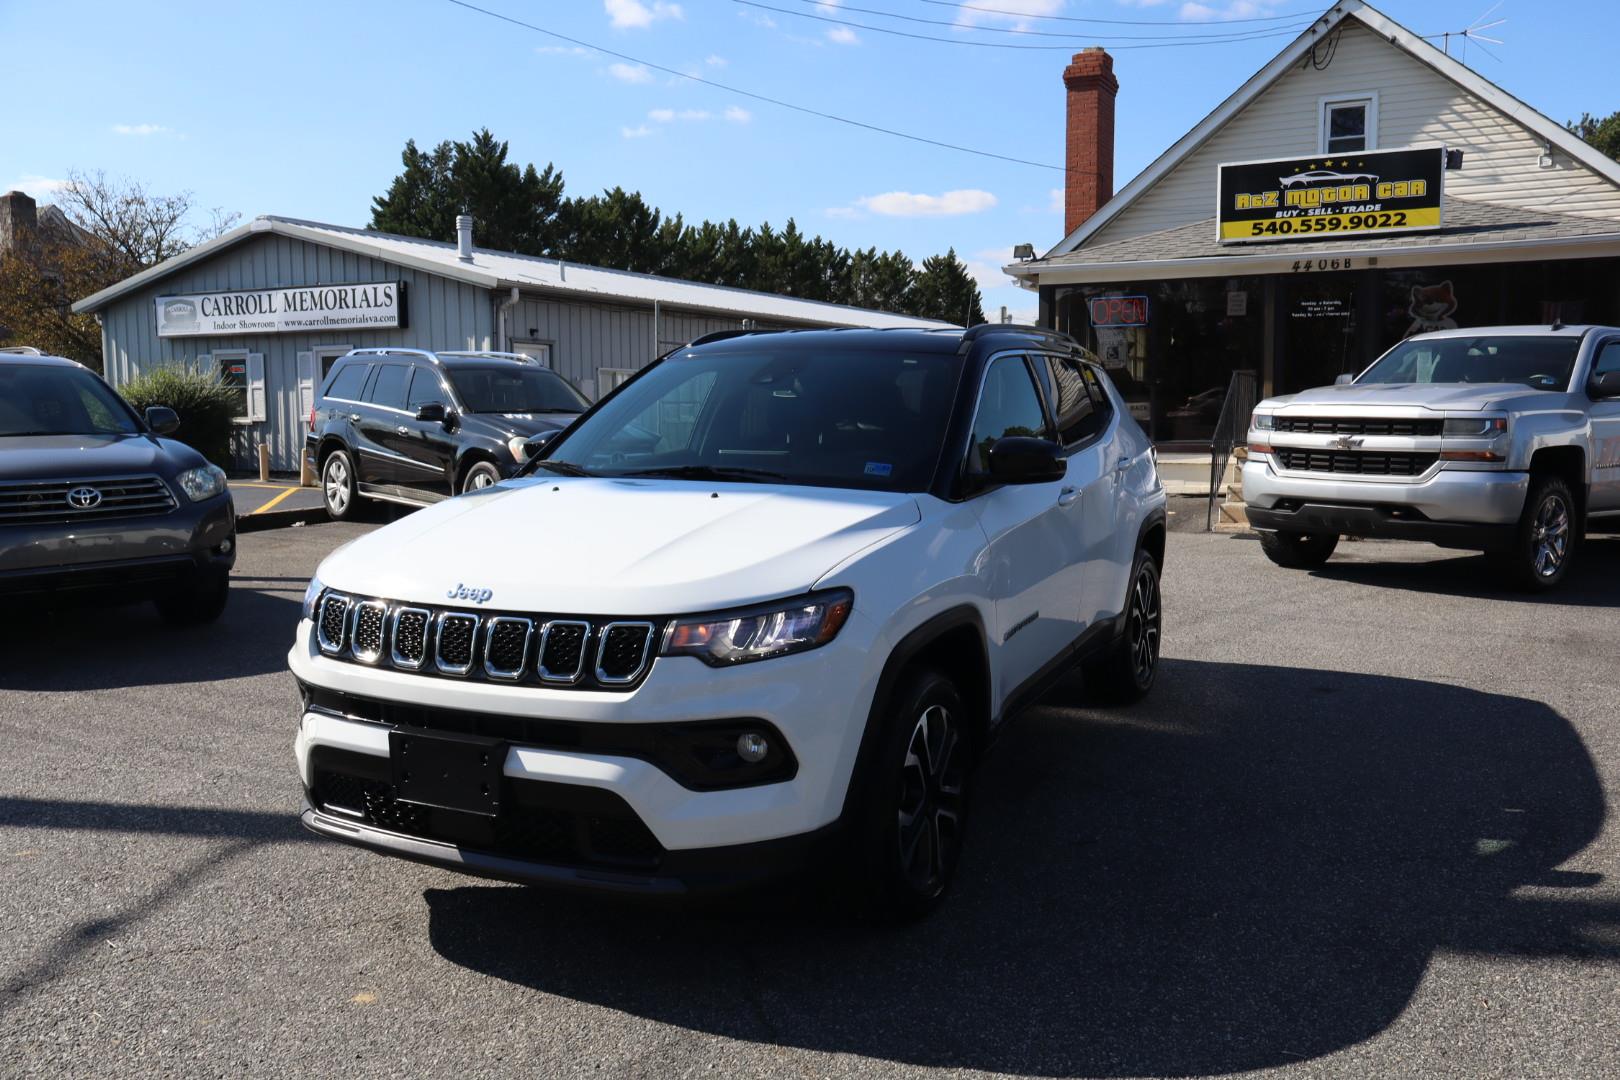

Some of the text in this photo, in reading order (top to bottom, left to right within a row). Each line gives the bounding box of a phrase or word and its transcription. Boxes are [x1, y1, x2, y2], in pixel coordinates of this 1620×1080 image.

[1275, 204, 1382, 218] BUY SELL TRADE
[1251, 212, 1407, 236] 540.559.9022
[201, 285, 393, 317] CARROLL MEMORIALS
[1093, 298, 1146, 325] OPEN
[213, 314, 396, 330] Indoor Showroom www.carrollmemorialsva.com
[446, 581, 493, 604] Jeep
